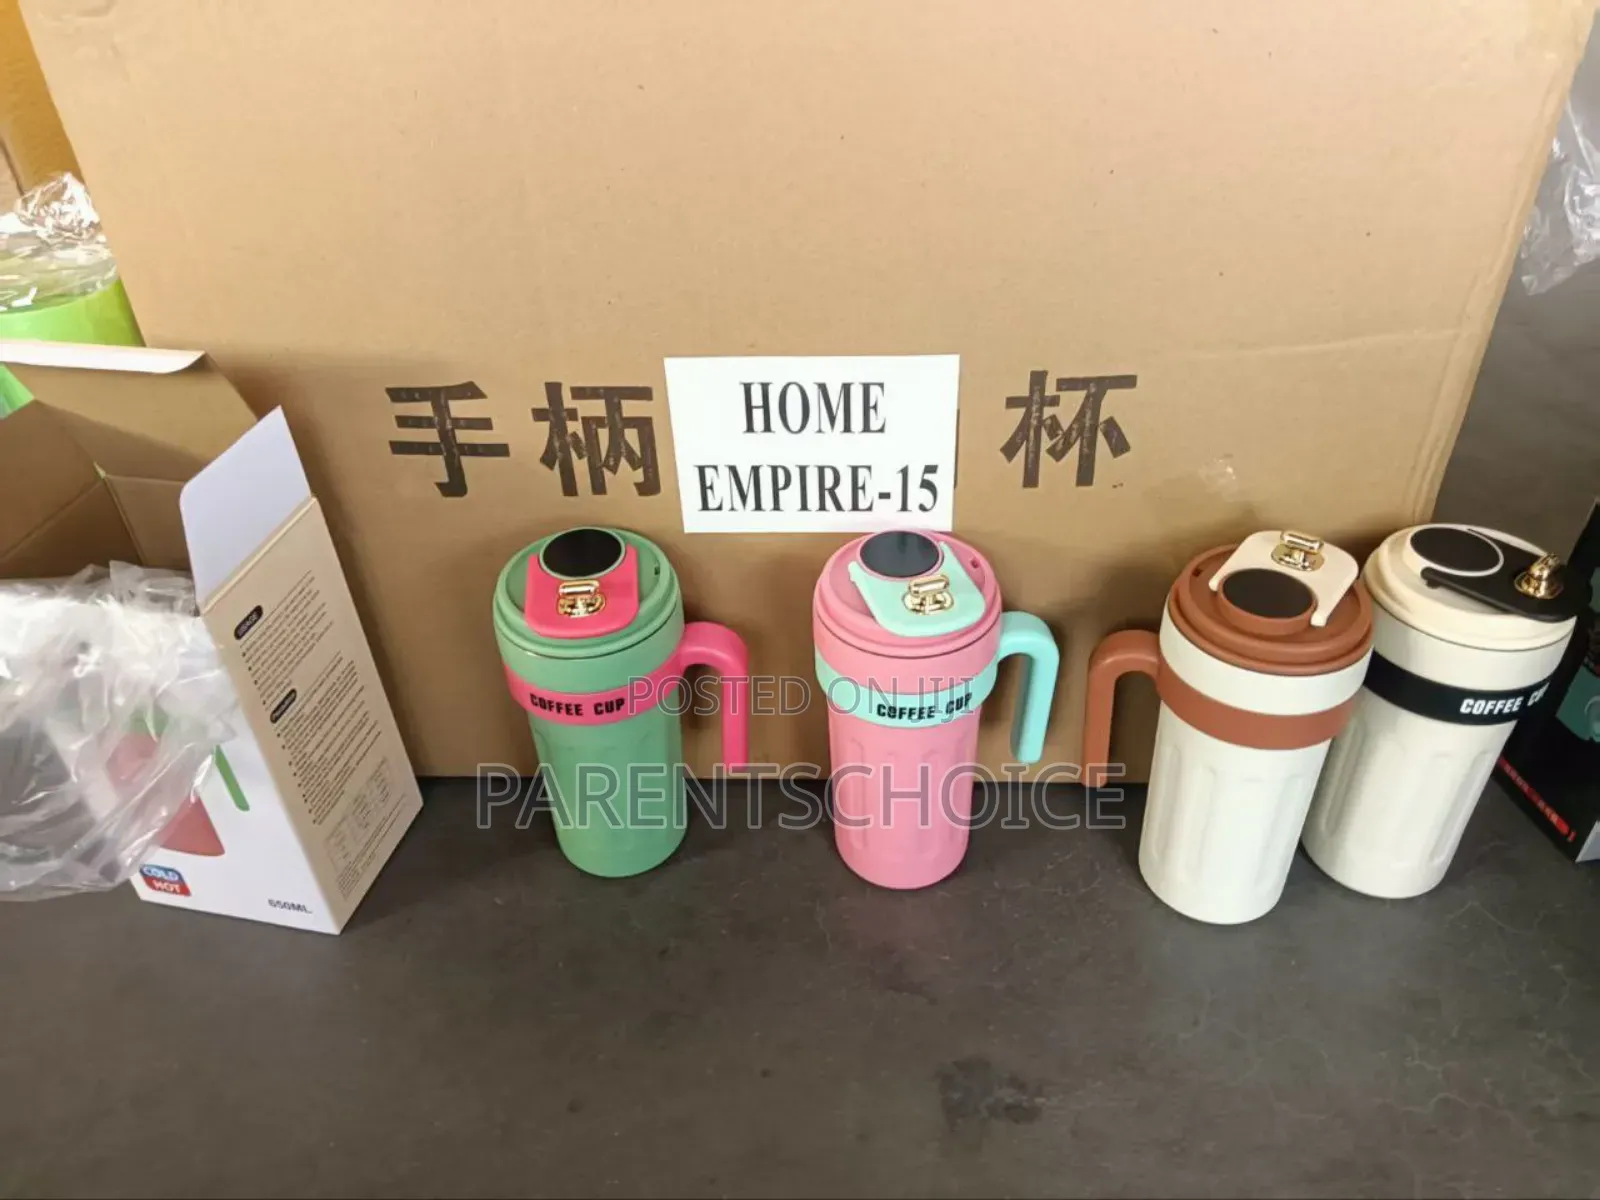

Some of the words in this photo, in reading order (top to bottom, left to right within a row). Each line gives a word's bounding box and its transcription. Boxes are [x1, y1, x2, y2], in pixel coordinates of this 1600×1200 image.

[740, 381, 886, 434] HOME
[693, 464, 938, 512] EMPIRE-15
[529, 692, 583, 716] COFFEE
[594, 698, 625, 716] CUP
[877, 703, 937, 720] COFFEE
[945, 692, 973, 715] CUP
[1459, 696, 1524, 714] COFFEE
[142, 866, 180, 882] COLD
[153, 880, 182, 893] HOT
